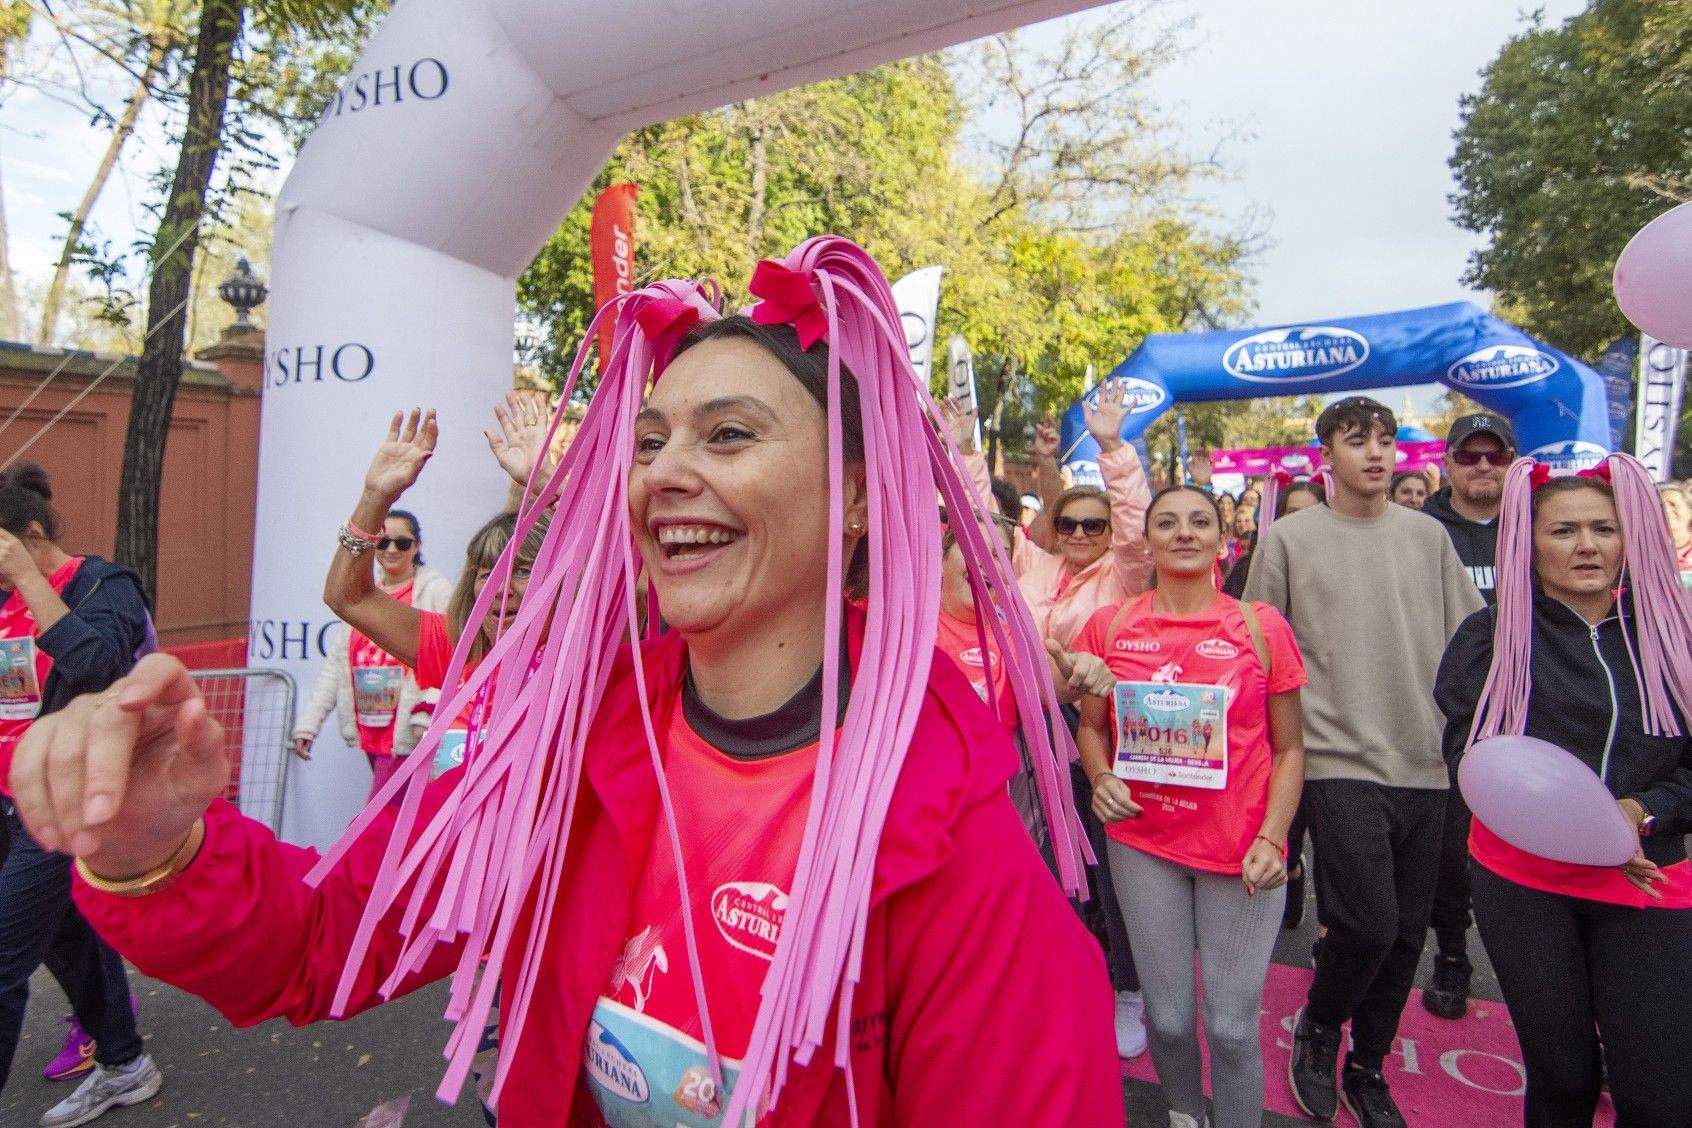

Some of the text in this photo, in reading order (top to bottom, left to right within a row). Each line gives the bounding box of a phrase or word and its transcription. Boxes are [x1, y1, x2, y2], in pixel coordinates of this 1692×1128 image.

[333, 57, 449, 116] YSHO
[266, 342, 375, 389] YSHO
[1234, 345, 1359, 373] ASTURIANA
[1644, 343, 1676, 474] YSHO
[1115, 638, 1161, 652] OYSHO
[1147, 696, 1188, 707] ASTURIANA
[1125, 765, 1157, 775] OYSHO
[715, 893, 780, 944] ASTURI
